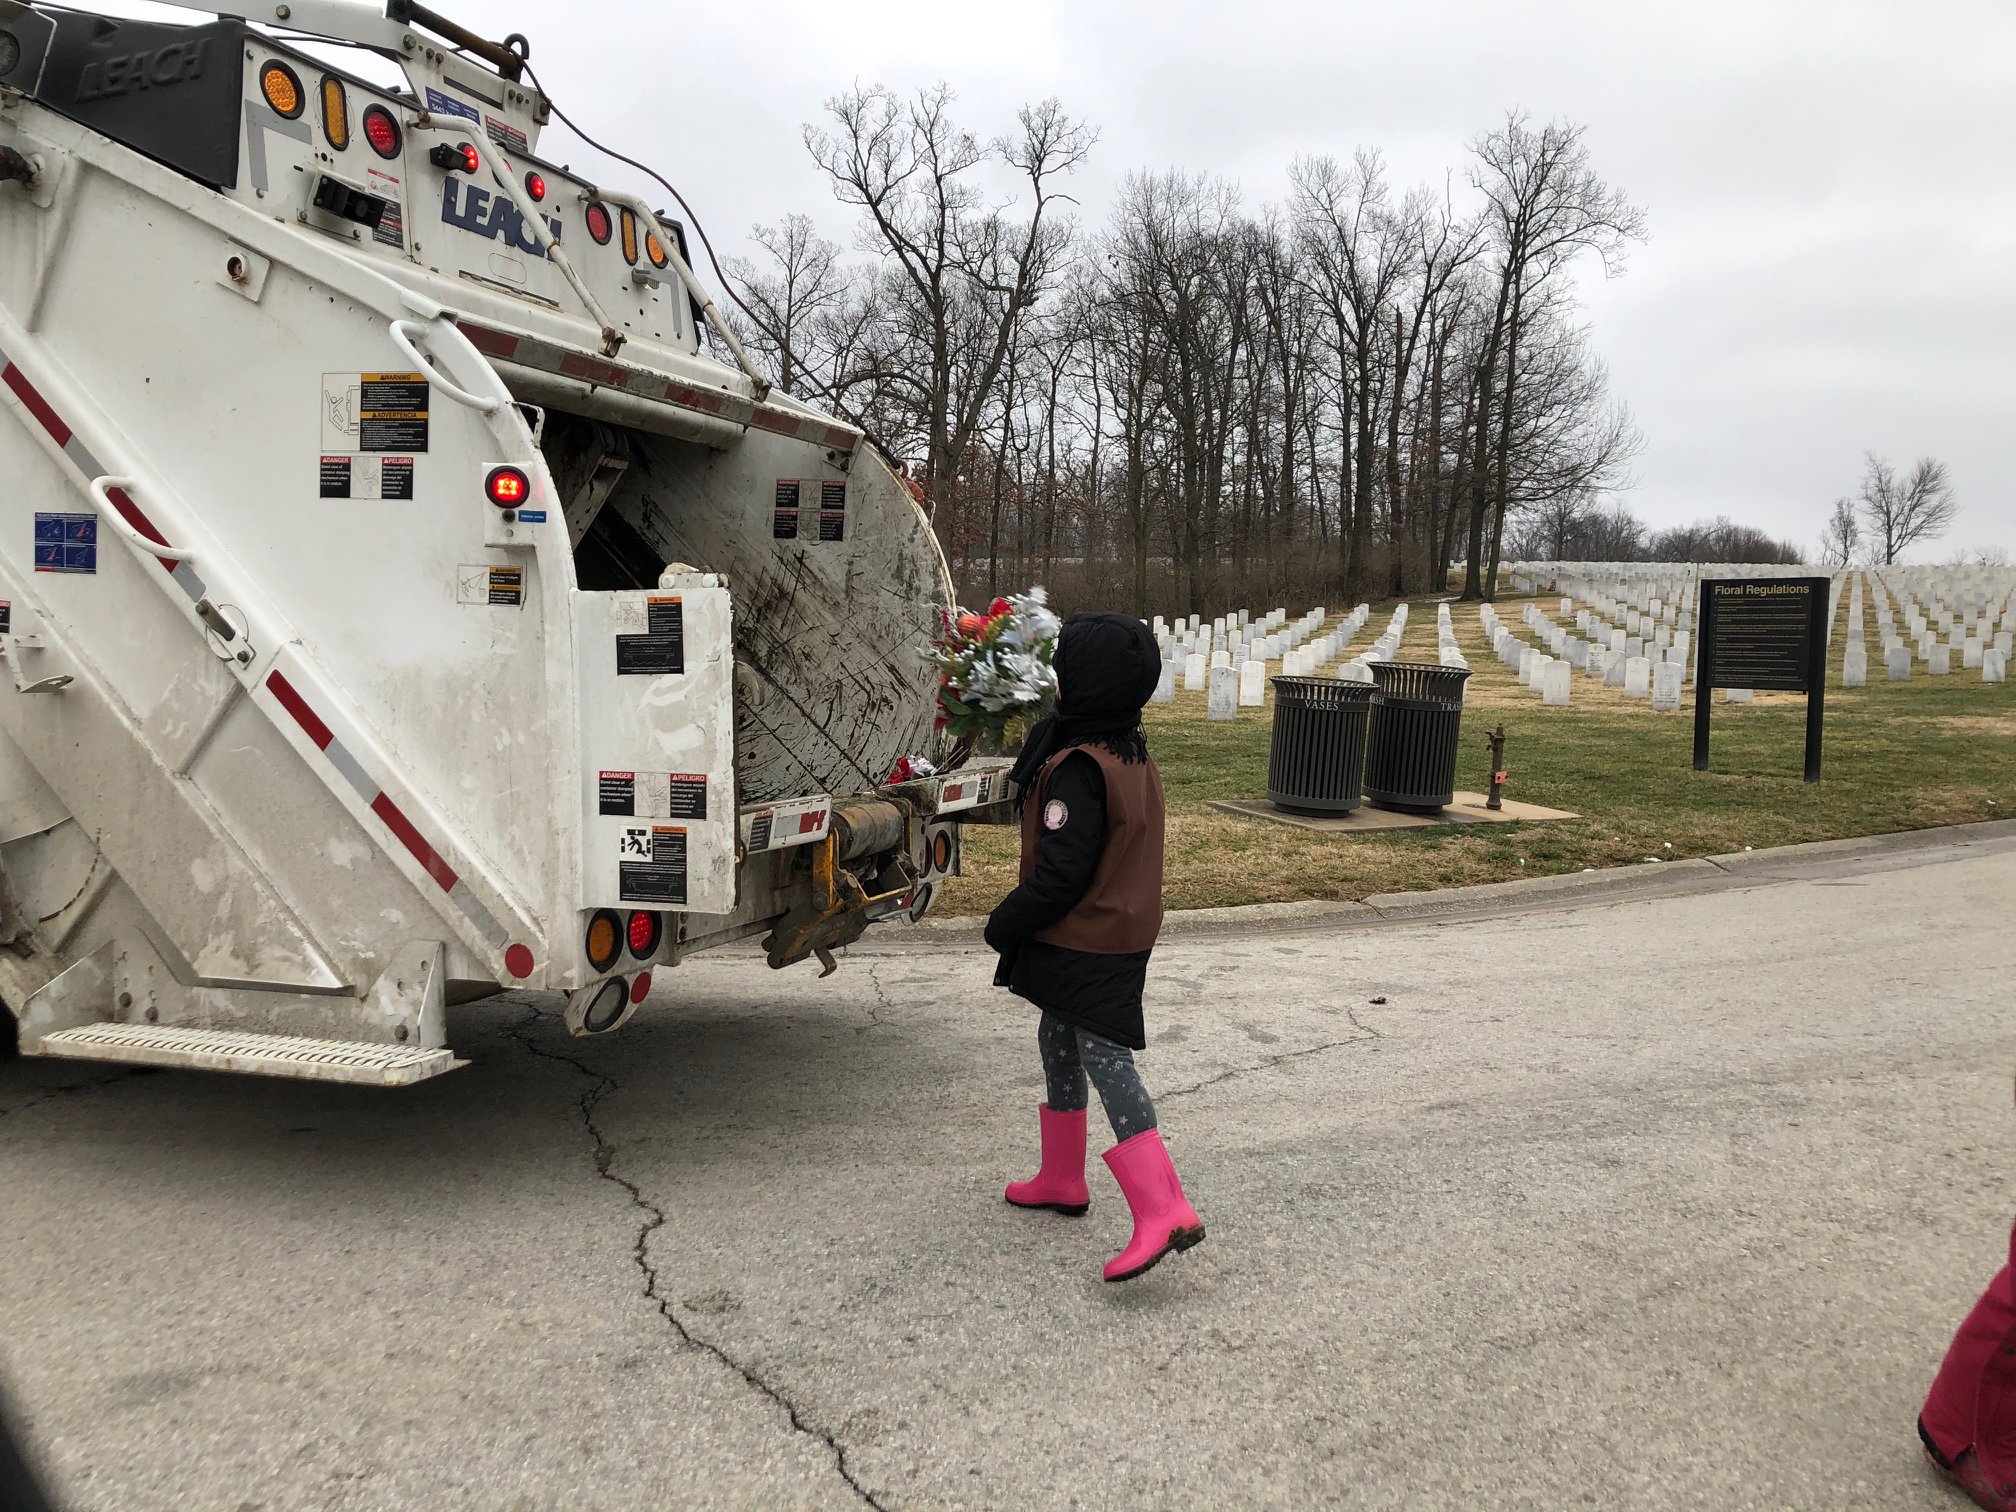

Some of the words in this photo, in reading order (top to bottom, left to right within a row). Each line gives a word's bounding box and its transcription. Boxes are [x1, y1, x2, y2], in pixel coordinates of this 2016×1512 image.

[75, 37, 212, 102] LEACH
[1714, 585, 1743, 595] Floral
[1746, 584, 1810, 596] Regulations
[1304, 699, 1339, 711] VASES
[1441, 702, 1461, 711] TRAS
